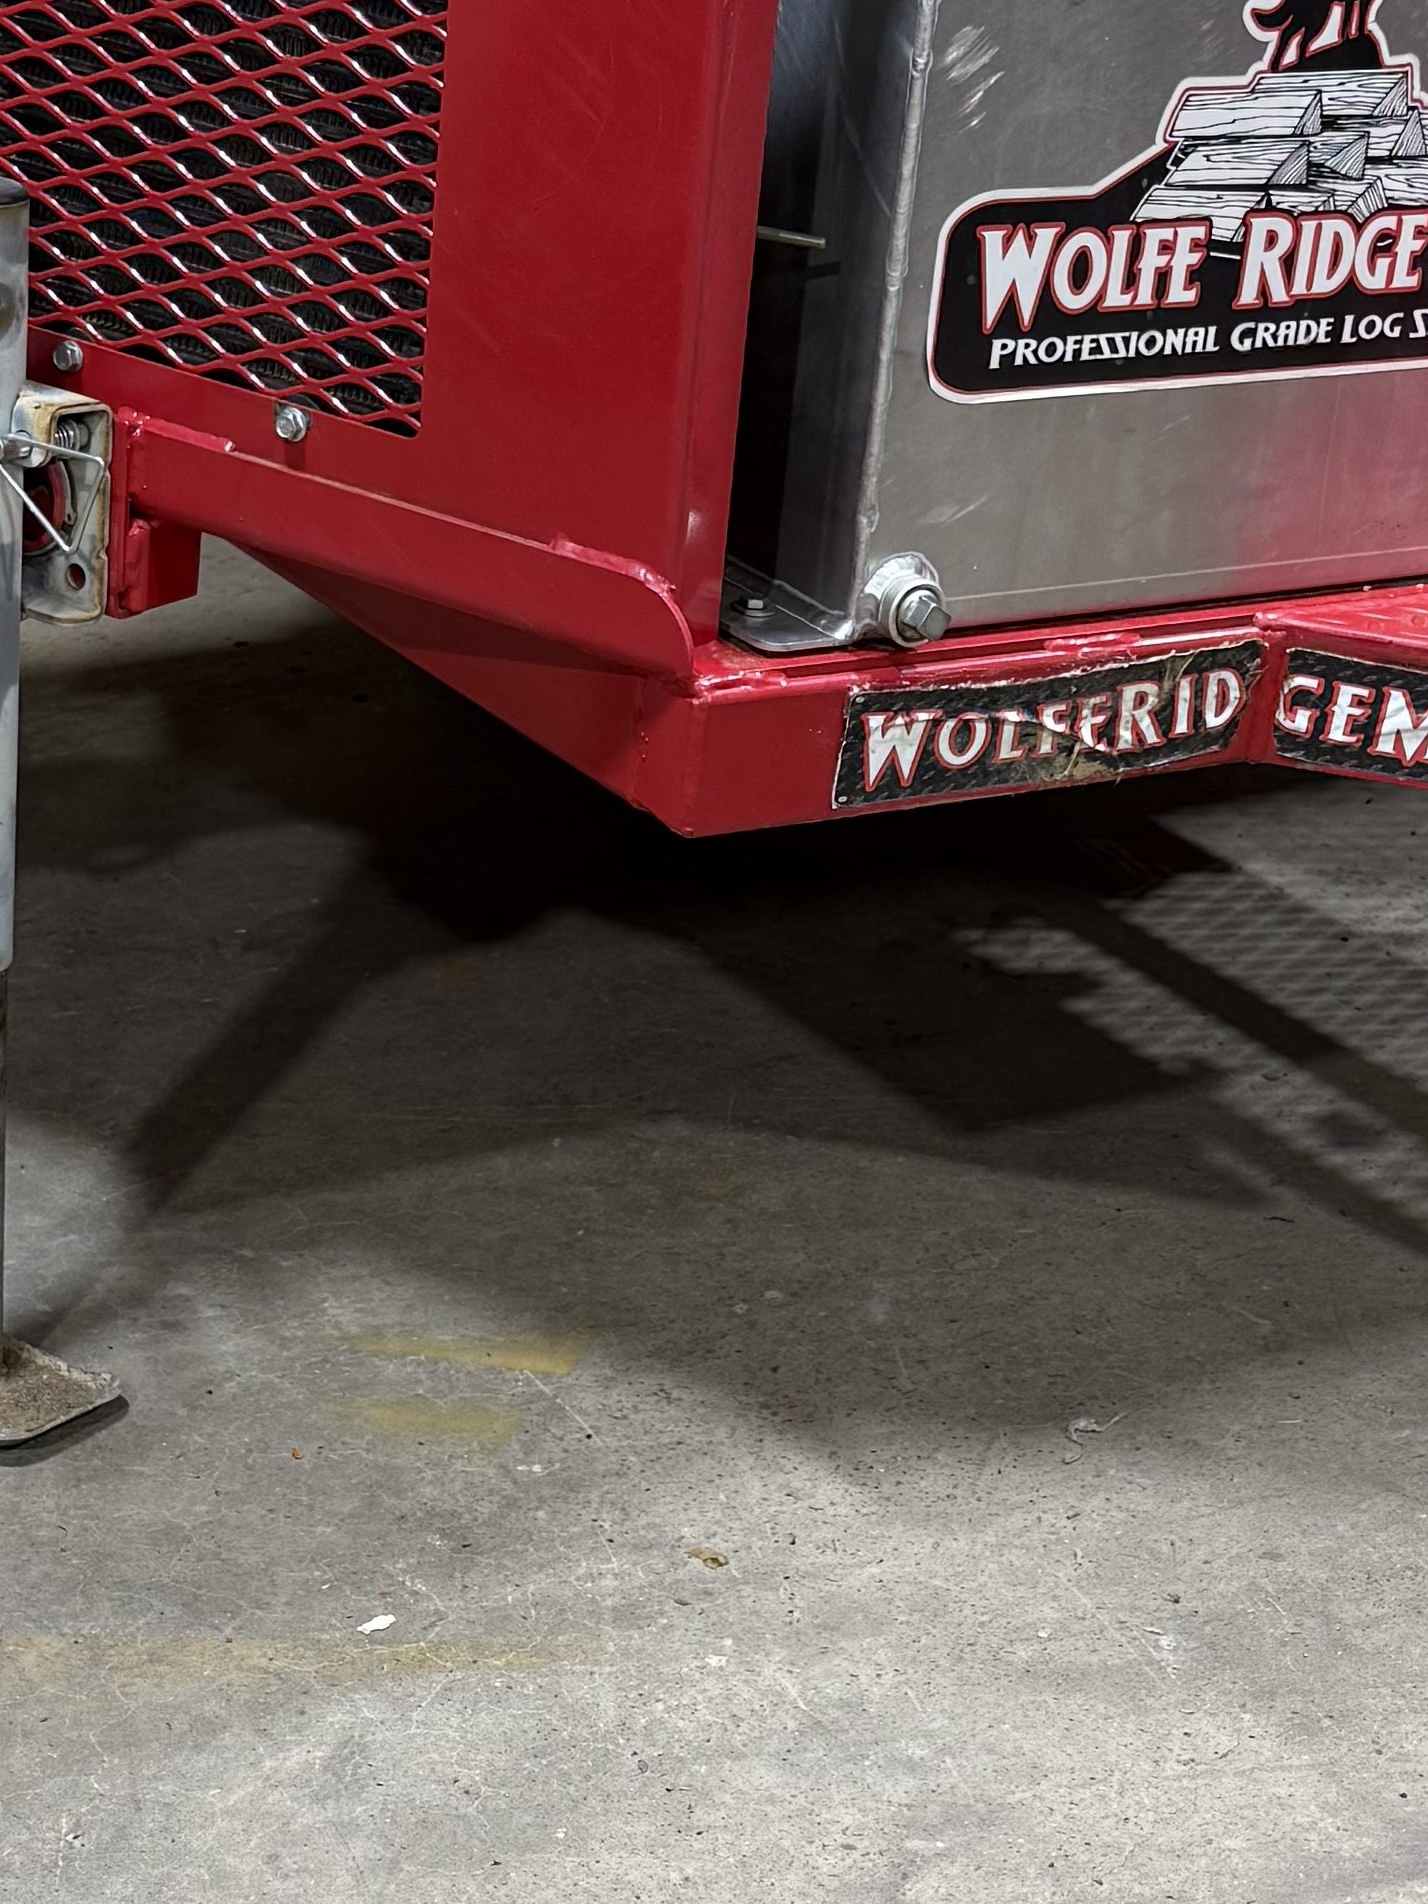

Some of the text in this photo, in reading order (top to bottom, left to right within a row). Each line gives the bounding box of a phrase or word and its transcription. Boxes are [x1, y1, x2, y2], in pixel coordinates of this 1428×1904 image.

[977, 221, 1213, 335] WOLFE
[988, 325, 1219, 370] PROFESSIONAL
[1230, 317, 1332, 350] GRADE
[1340, 312, 1405, 344] LOG
